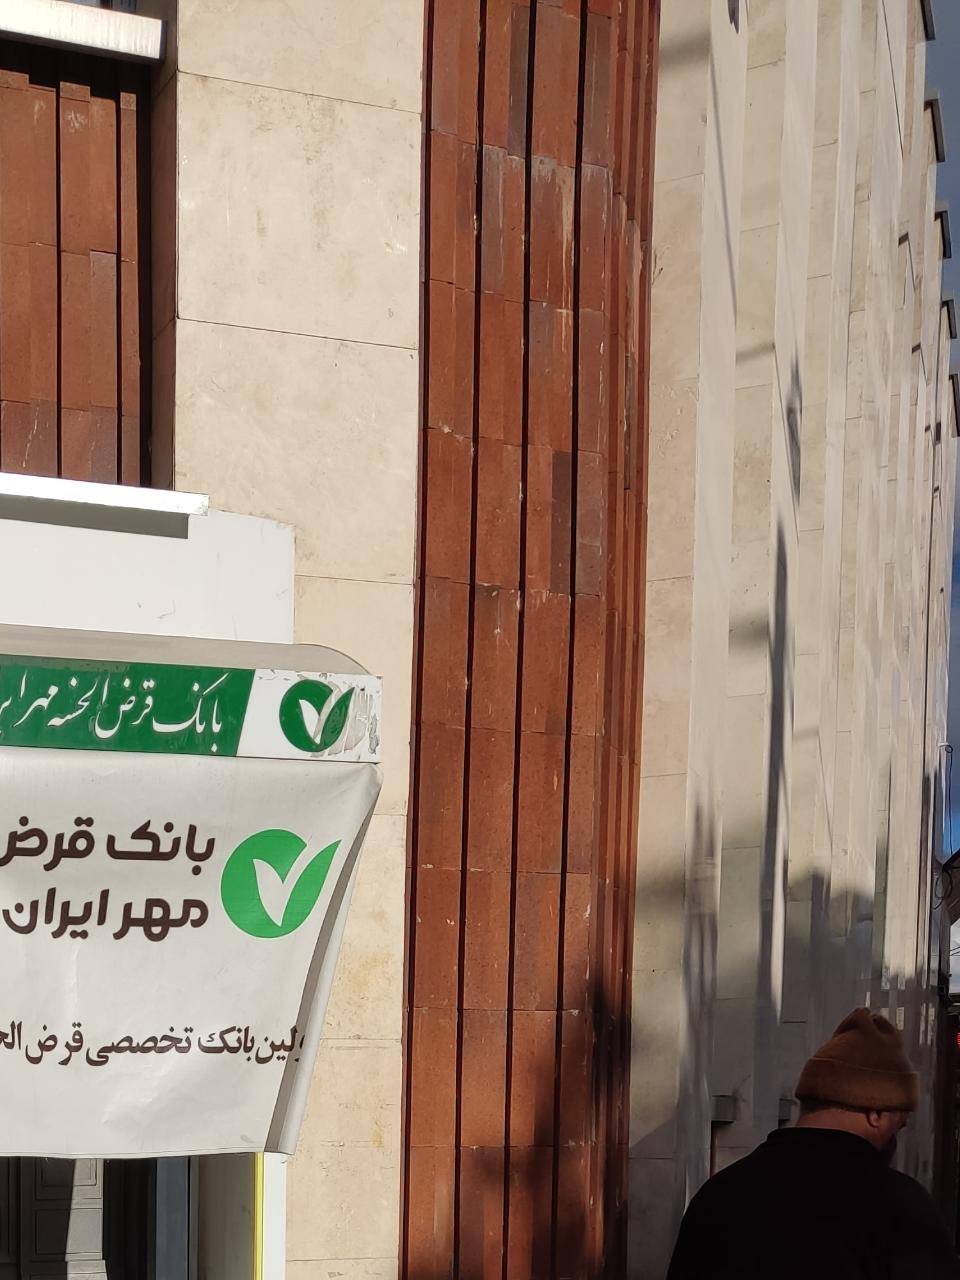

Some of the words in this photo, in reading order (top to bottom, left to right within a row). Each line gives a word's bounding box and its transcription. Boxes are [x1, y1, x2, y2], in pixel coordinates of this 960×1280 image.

[13, 685, 59, 727] مهر
[48, 674, 109, 727] الحسنه
[95, 677, 155, 739] قرض
[153, 672, 231, 752] بانک
[106, 819, 215, 876] بانک
[2, 887, 110, 940] ایران
[112, 898, 209, 942] مهر
[25, 1021, 84, 1067] قرض
[86, 1026, 194, 1067] تخصصی
